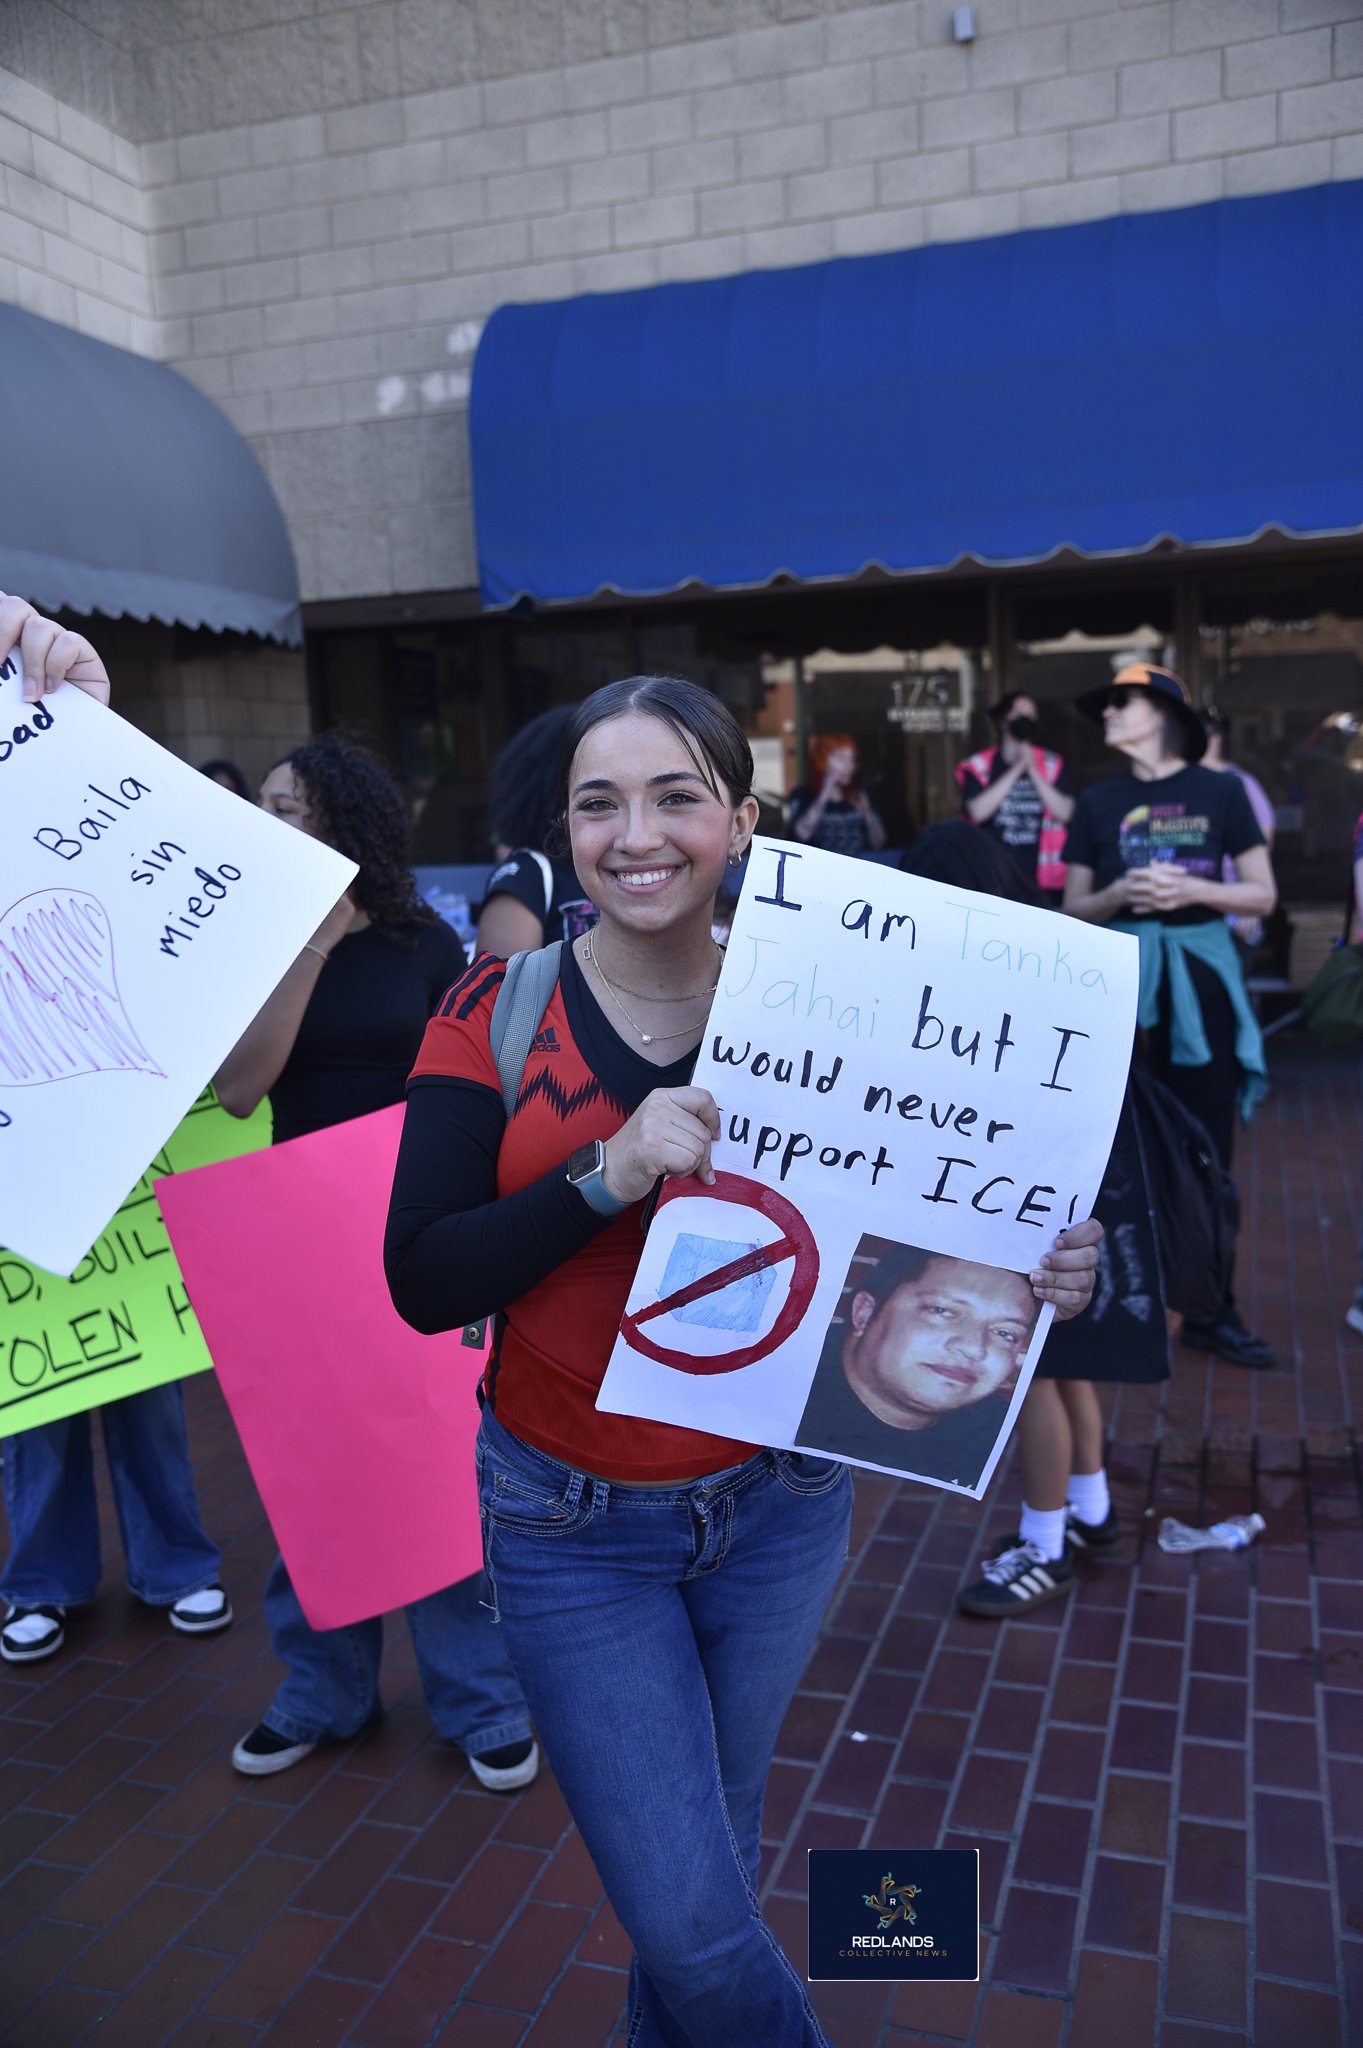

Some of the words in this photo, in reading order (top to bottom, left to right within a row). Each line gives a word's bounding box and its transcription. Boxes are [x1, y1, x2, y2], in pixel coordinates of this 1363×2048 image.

[34, 777, 151, 860] Baila
[131, 842, 186, 885] sin
[755, 848, 803, 911] I
[842, 899, 916, 949] am
[945, 901, 1109, 995] Tanka
[725, 935, 880, 1038] Jahai
[911, 985, 1015, 1073] but
[1040, 1026, 1090, 1092] I
[712, 1036, 843, 1093] would
[863, 1086, 1014, 1143] never
[717, 1107, 895, 1186] upport
[921, 1156, 1079, 1234] ICE!
[0, 1300, 138, 1387] OLEN
